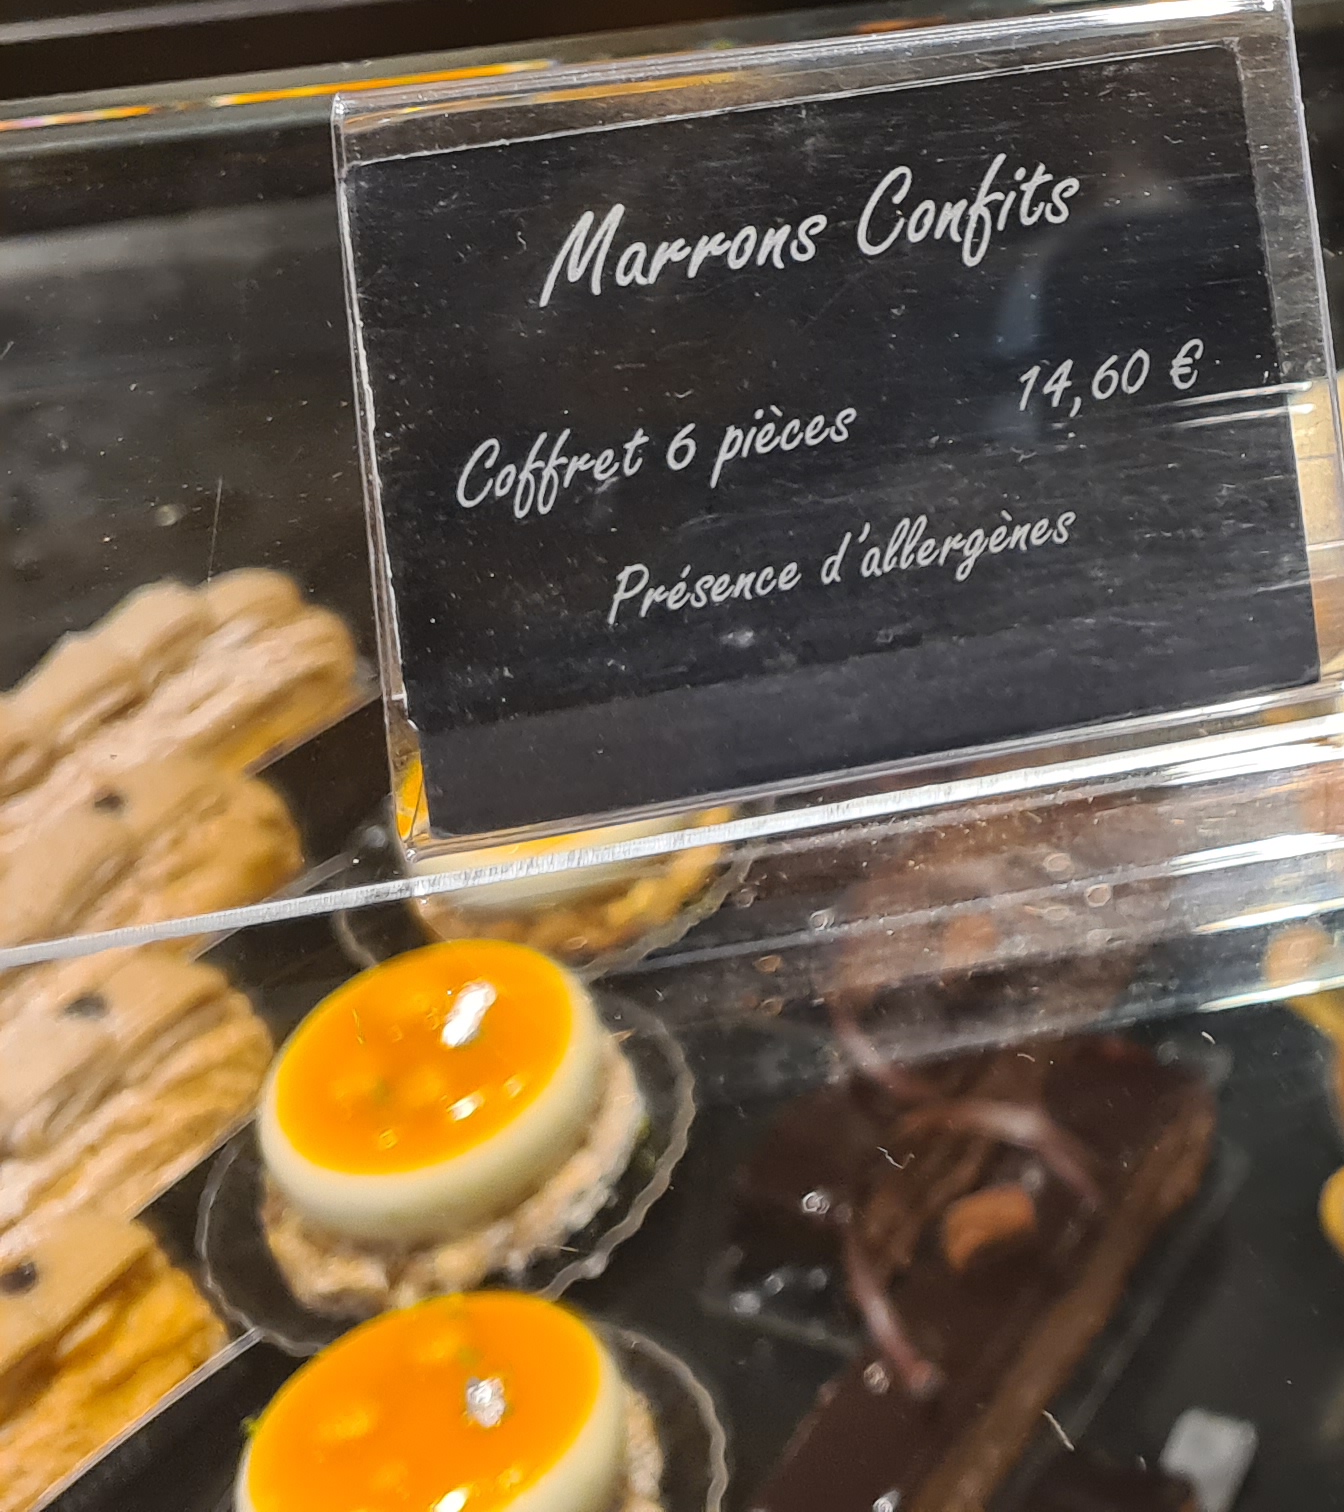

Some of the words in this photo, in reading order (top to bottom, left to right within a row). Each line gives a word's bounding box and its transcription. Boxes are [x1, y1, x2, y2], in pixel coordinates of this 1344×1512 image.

[538, 202, 828, 308] Marrons
[857, 153, 1082, 268] Confits
[455, 428, 650, 521] Coffret
[667, 423, 698, 468] 6
[710, 404, 858, 488] pièces
[1017, 348, 1152, 418] 14,60
[1169, 338, 1204, 390] €
[607, 560, 801, 626] Présence
[820, 508, 1076, 582] d'allergènes
